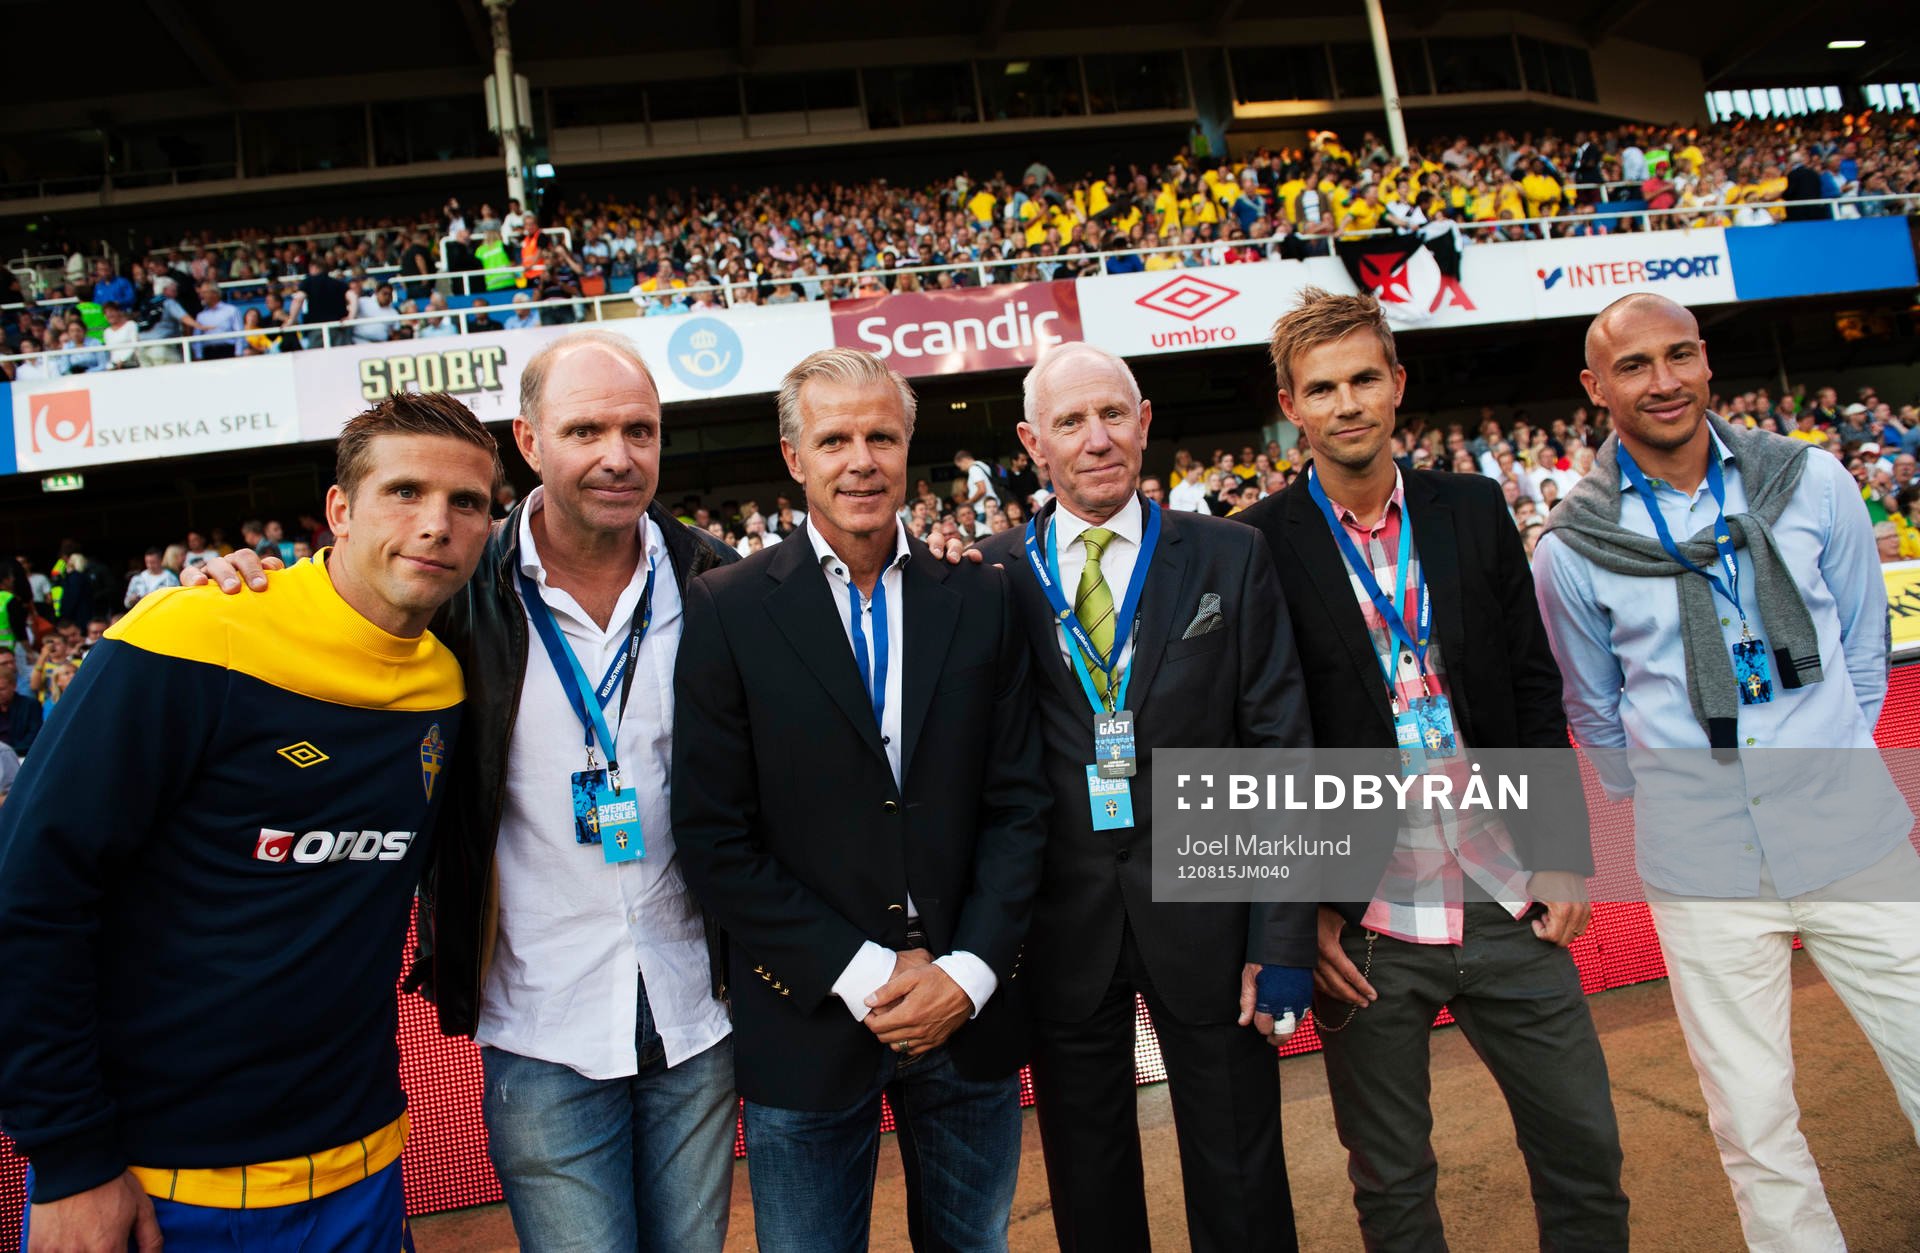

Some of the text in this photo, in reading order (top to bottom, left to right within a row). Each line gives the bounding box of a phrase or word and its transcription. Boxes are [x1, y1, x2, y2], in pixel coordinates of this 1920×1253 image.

[1567, 255, 1720, 289] INTERSPORT
[857, 301, 1063, 360] Scandic
[1151, 325, 1237, 348] umbro
[359, 345, 507, 402] SPORT
[97, 411, 279, 447] SVENSKA SPEL
[601, 651, 628, 698] NATIONALSPORTEN
[1099, 719, 1130, 735] GÄST
[598, 800, 636, 815] SVERIGE
[599, 810, 637, 824] BRASILIEN
[293, 830, 417, 864] ODDS
